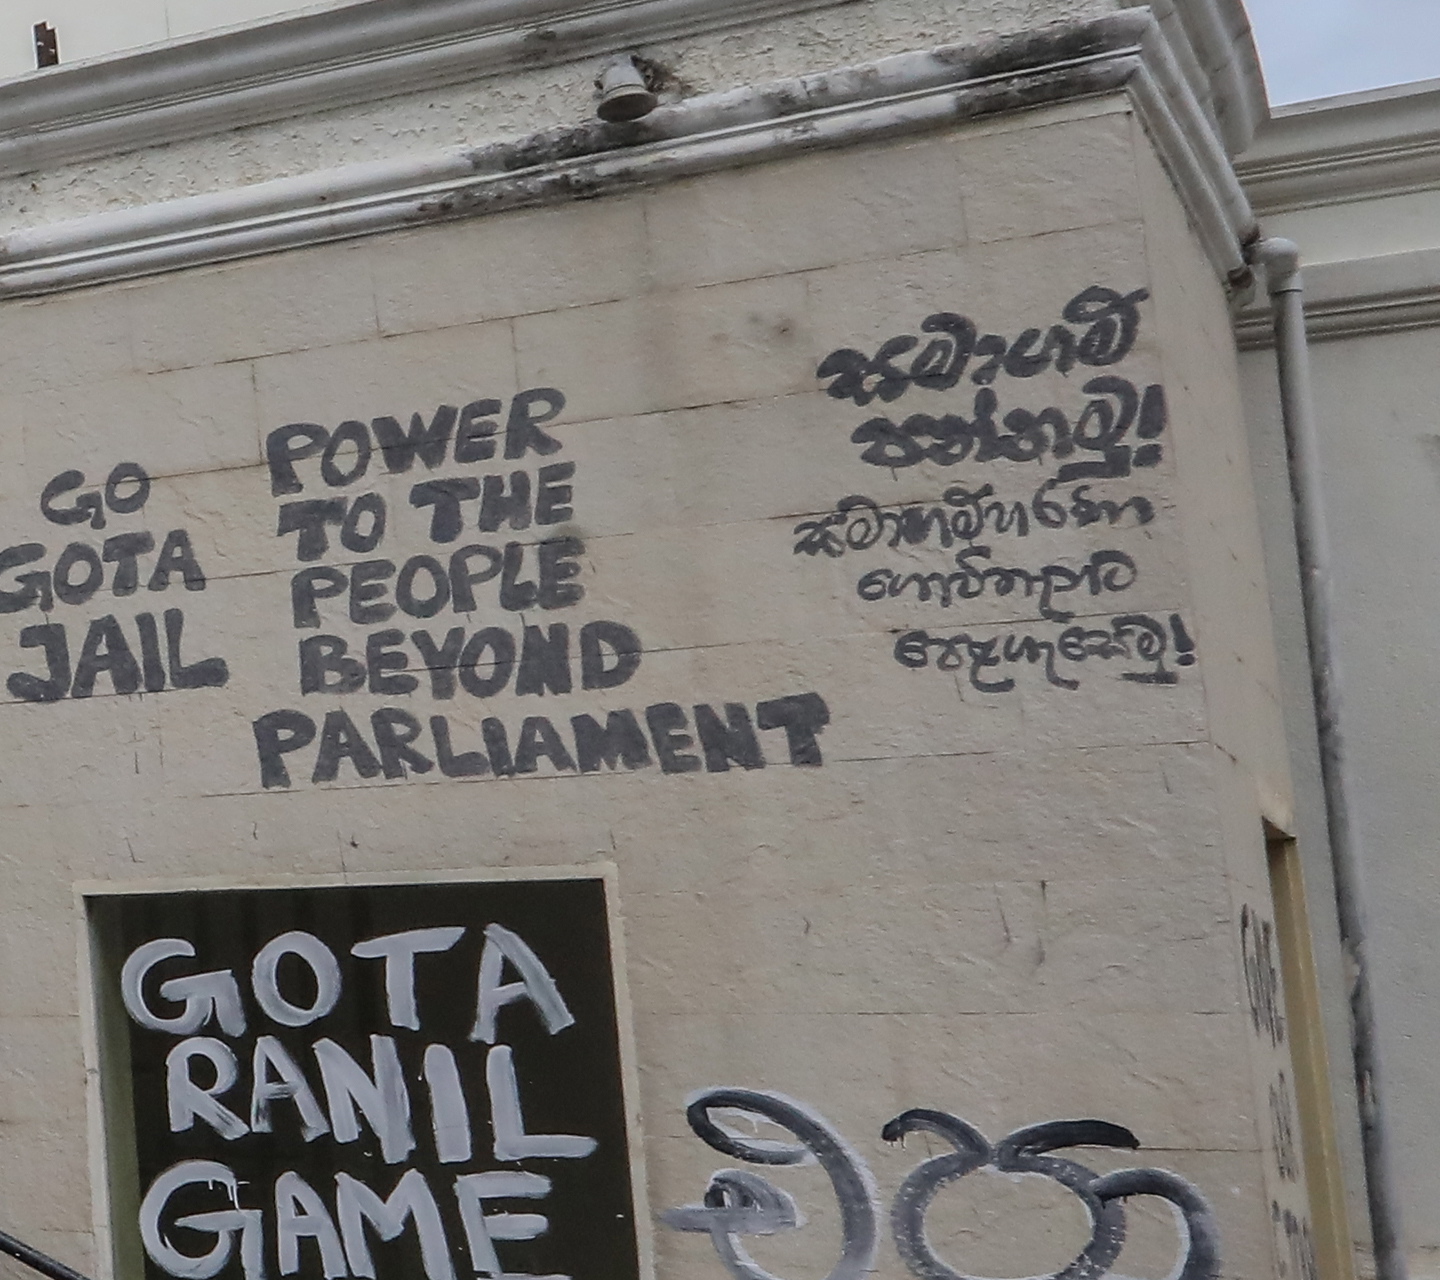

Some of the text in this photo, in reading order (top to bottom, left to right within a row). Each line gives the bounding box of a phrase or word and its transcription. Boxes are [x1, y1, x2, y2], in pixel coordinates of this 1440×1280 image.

[265, 386, 568, 498] POWER
[39, 461, 152, 530] GO
[278, 460, 579, 564] TO THE
[291, 534, 587, 630] PEOPLE
[6, 608, 229, 703] JAIL
[298, 620, 643, 700] BEYOND
[252, 691, 832, 790] PARLIAMENT
[120, 922, 577, 1040] GOTA
[166, 1032, 596, 1164] RANIL
